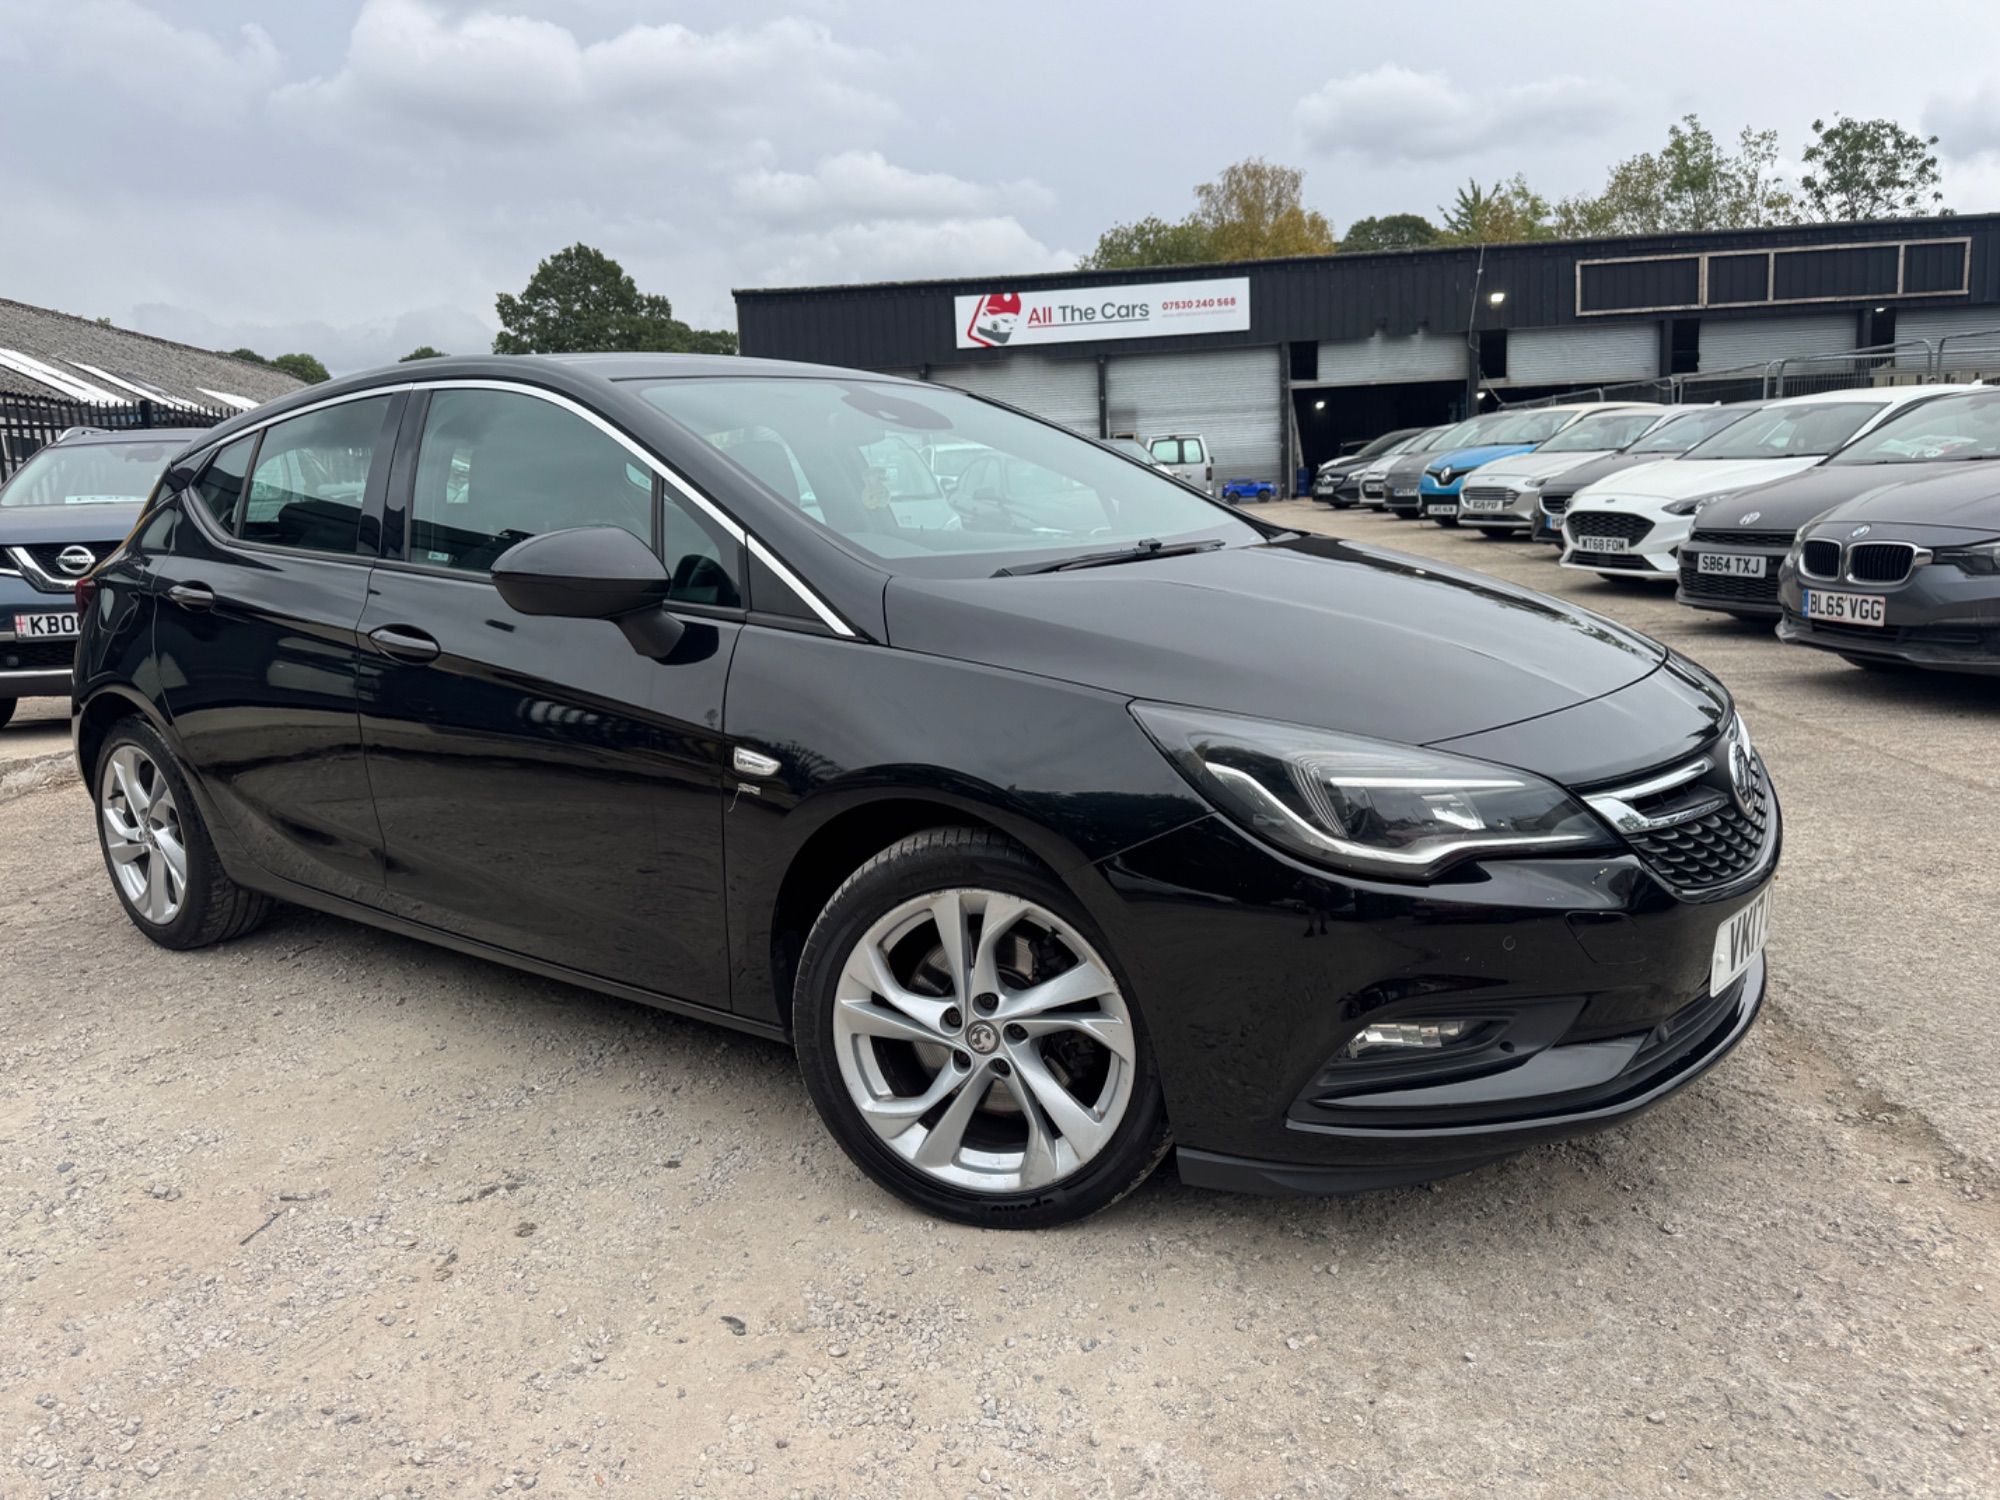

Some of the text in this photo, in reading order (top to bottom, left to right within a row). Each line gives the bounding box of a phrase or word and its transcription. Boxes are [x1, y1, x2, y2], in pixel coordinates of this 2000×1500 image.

[1027, 306, 1053, 324] All
[1058, 304, 1096, 322] The
[1101, 302, 1150, 319] Cars
[1161, 300, 1194, 311] 07530
[1195, 298, 1215, 308] 240
[1702, 555, 1760, 575] SB64 TXJ
[1810, 591, 1882, 622] BL65 VGG
